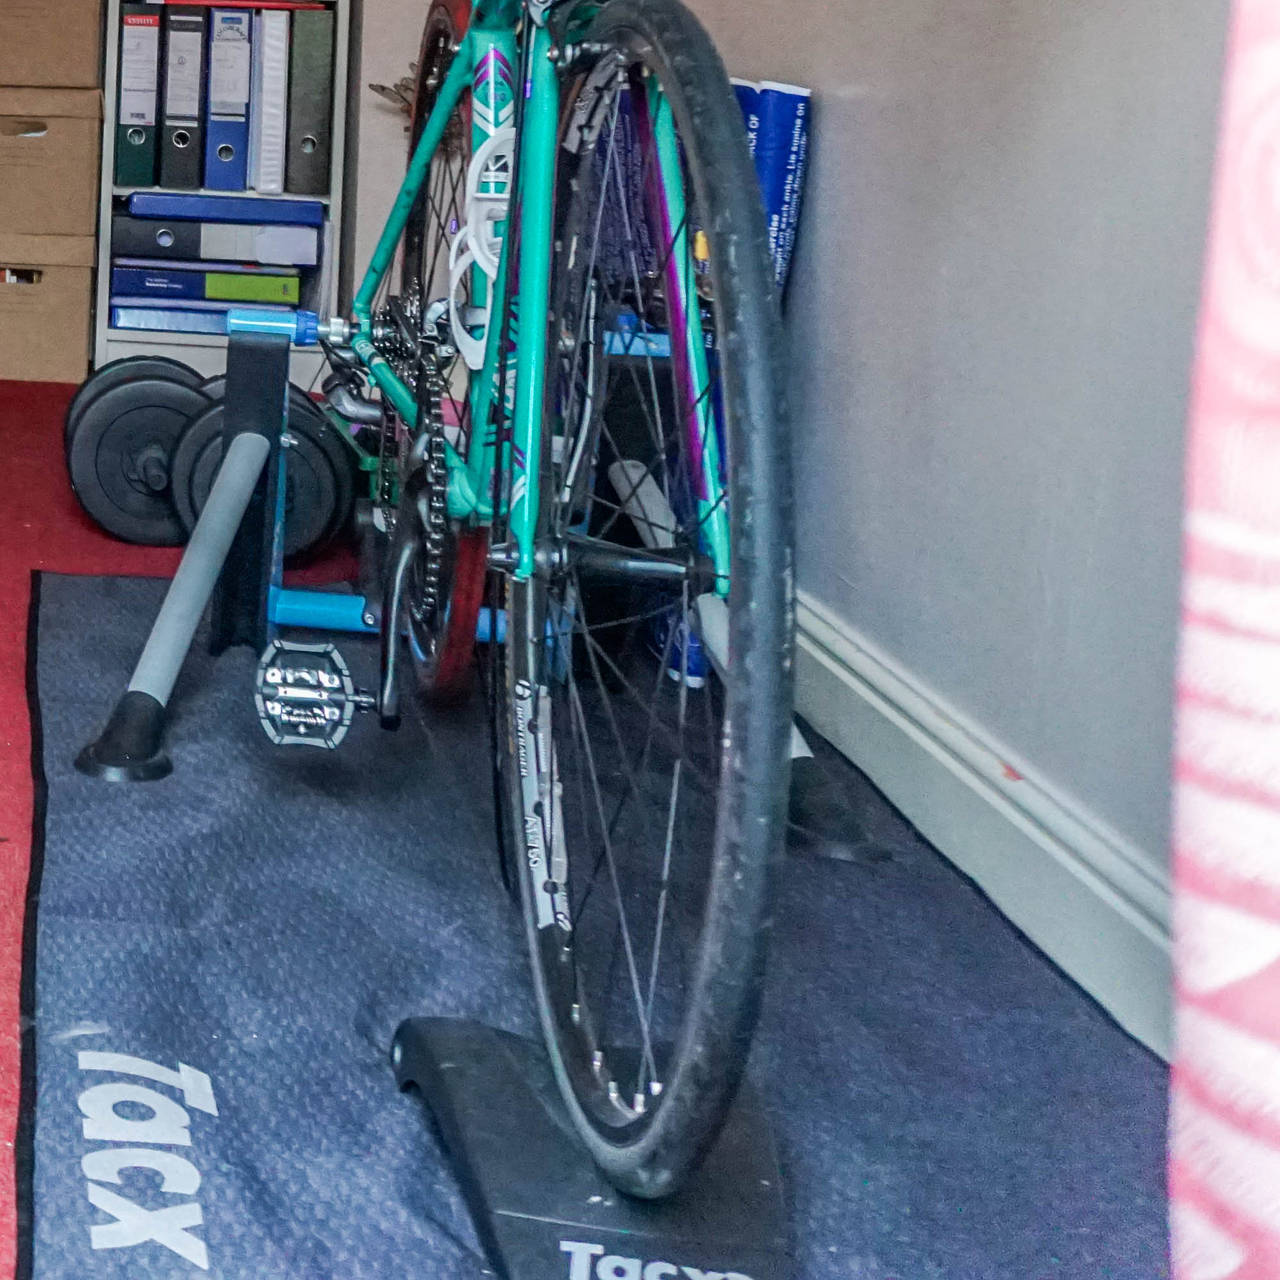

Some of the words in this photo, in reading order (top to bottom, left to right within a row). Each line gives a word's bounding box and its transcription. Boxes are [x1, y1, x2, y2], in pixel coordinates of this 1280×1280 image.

[796, 102, 806, 116] on
[515, 706, 528, 777] BONTRAGER
[76, 1051, 218, 1270] Tacx
